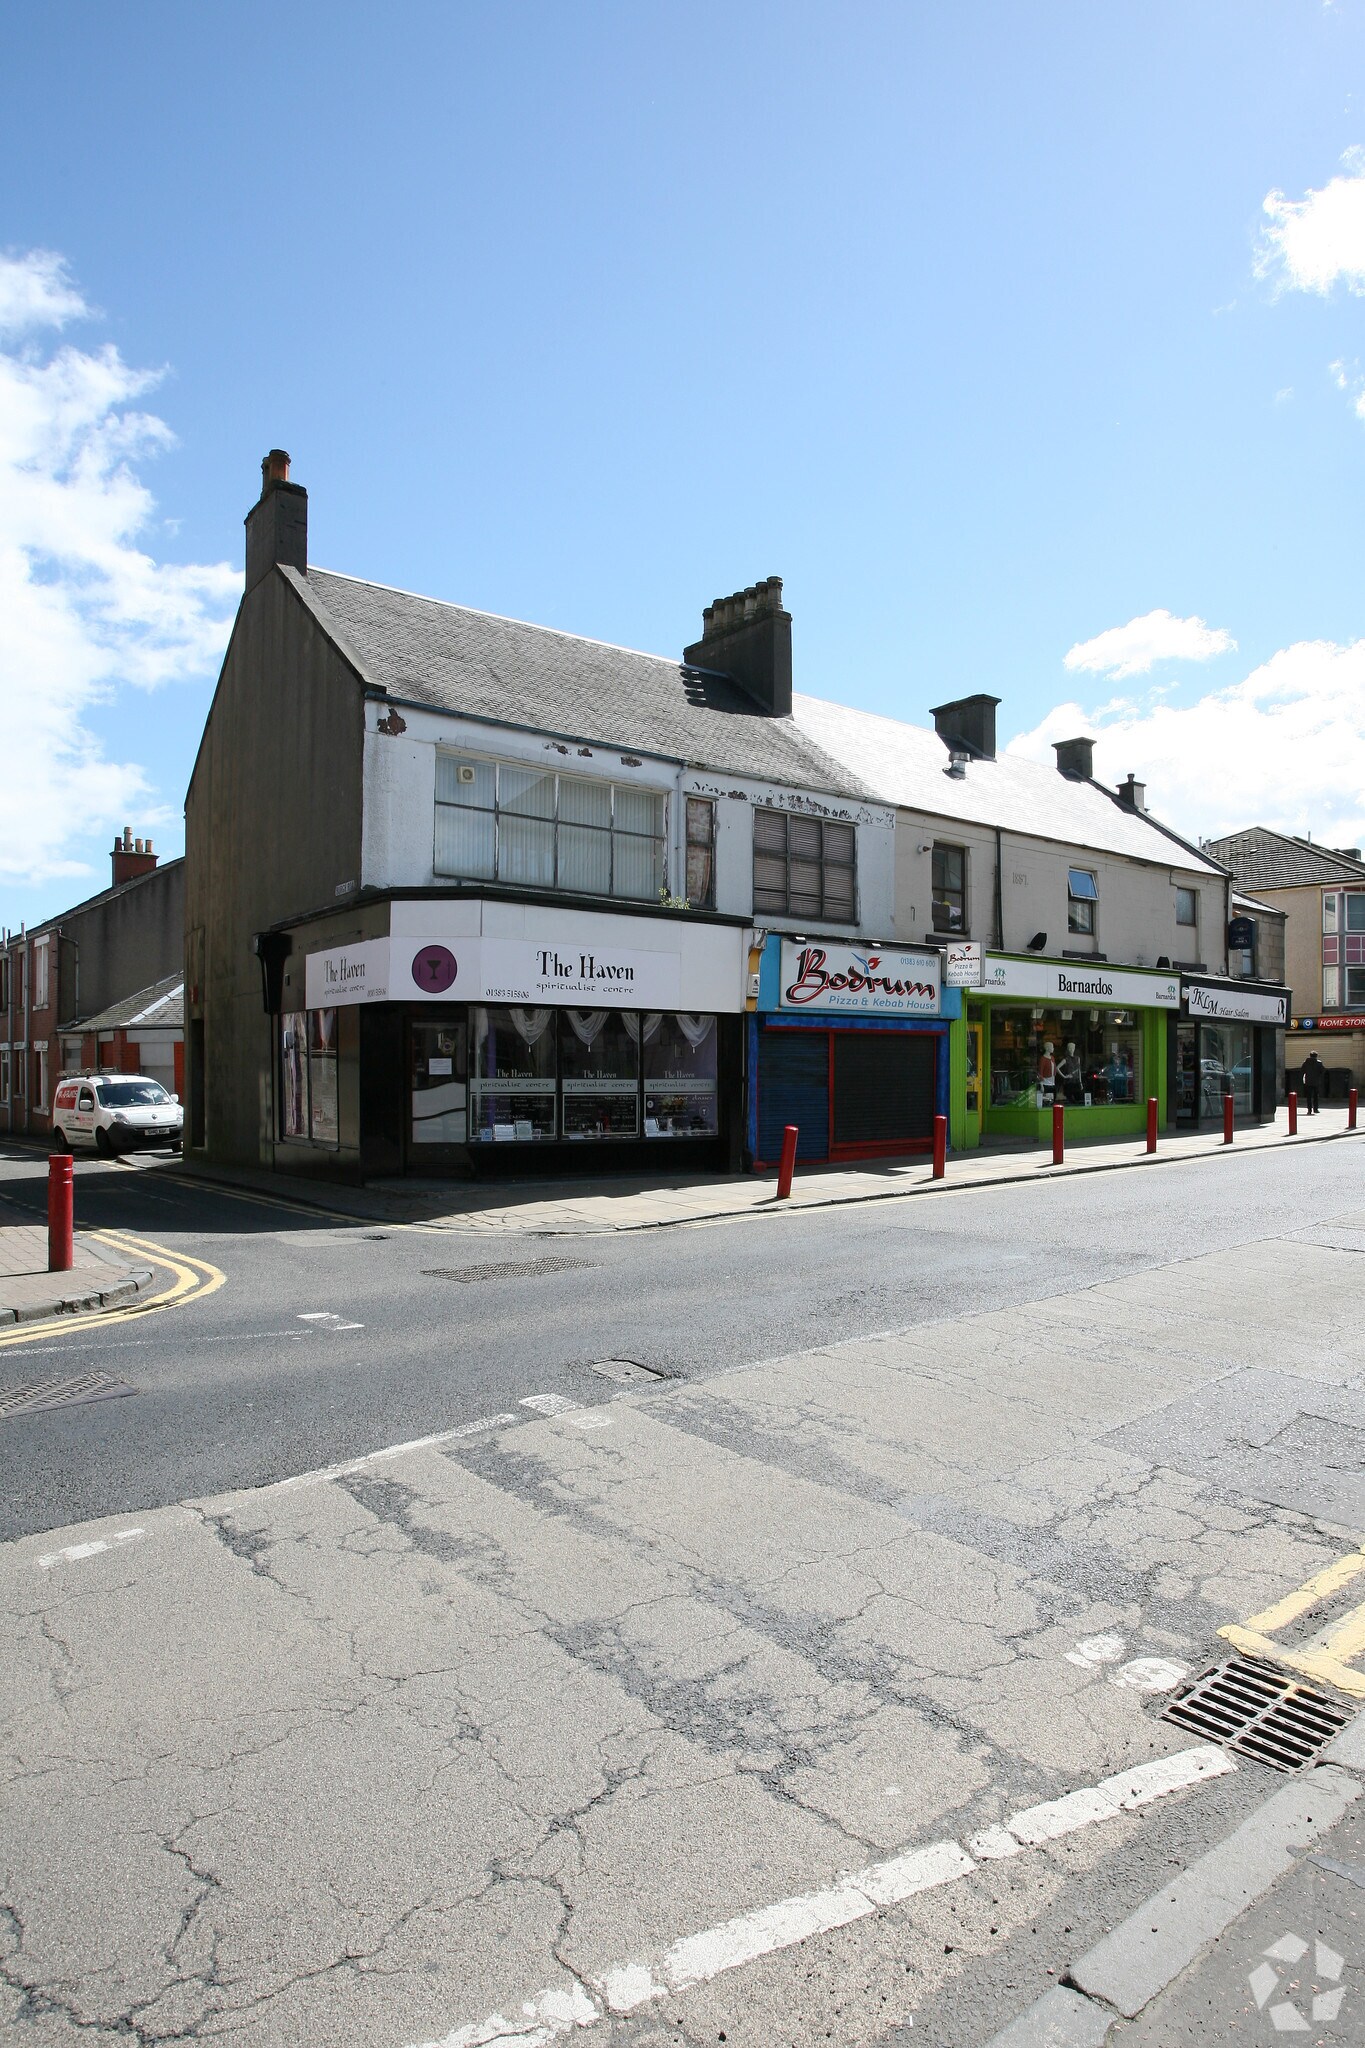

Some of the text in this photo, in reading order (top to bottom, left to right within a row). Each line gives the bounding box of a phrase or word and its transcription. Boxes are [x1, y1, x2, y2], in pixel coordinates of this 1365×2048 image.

[536, 950, 634, 981] The Haven
[900, 956, 936, 967] 01383 610 600
[948, 954, 980, 964] Bodrum
[324, 957, 366, 982] The Haven
[786, 948, 936, 1004] Bodrum
[536, 982, 634, 994] spiritualist centre
[1058, 974, 1112, 995] Barnardos
[829, 996, 935, 1010] Pizza & Kebab House
[1219, 1008, 1233, 1016] Hair
[1233, 1009, 1249, 1018] Salon
